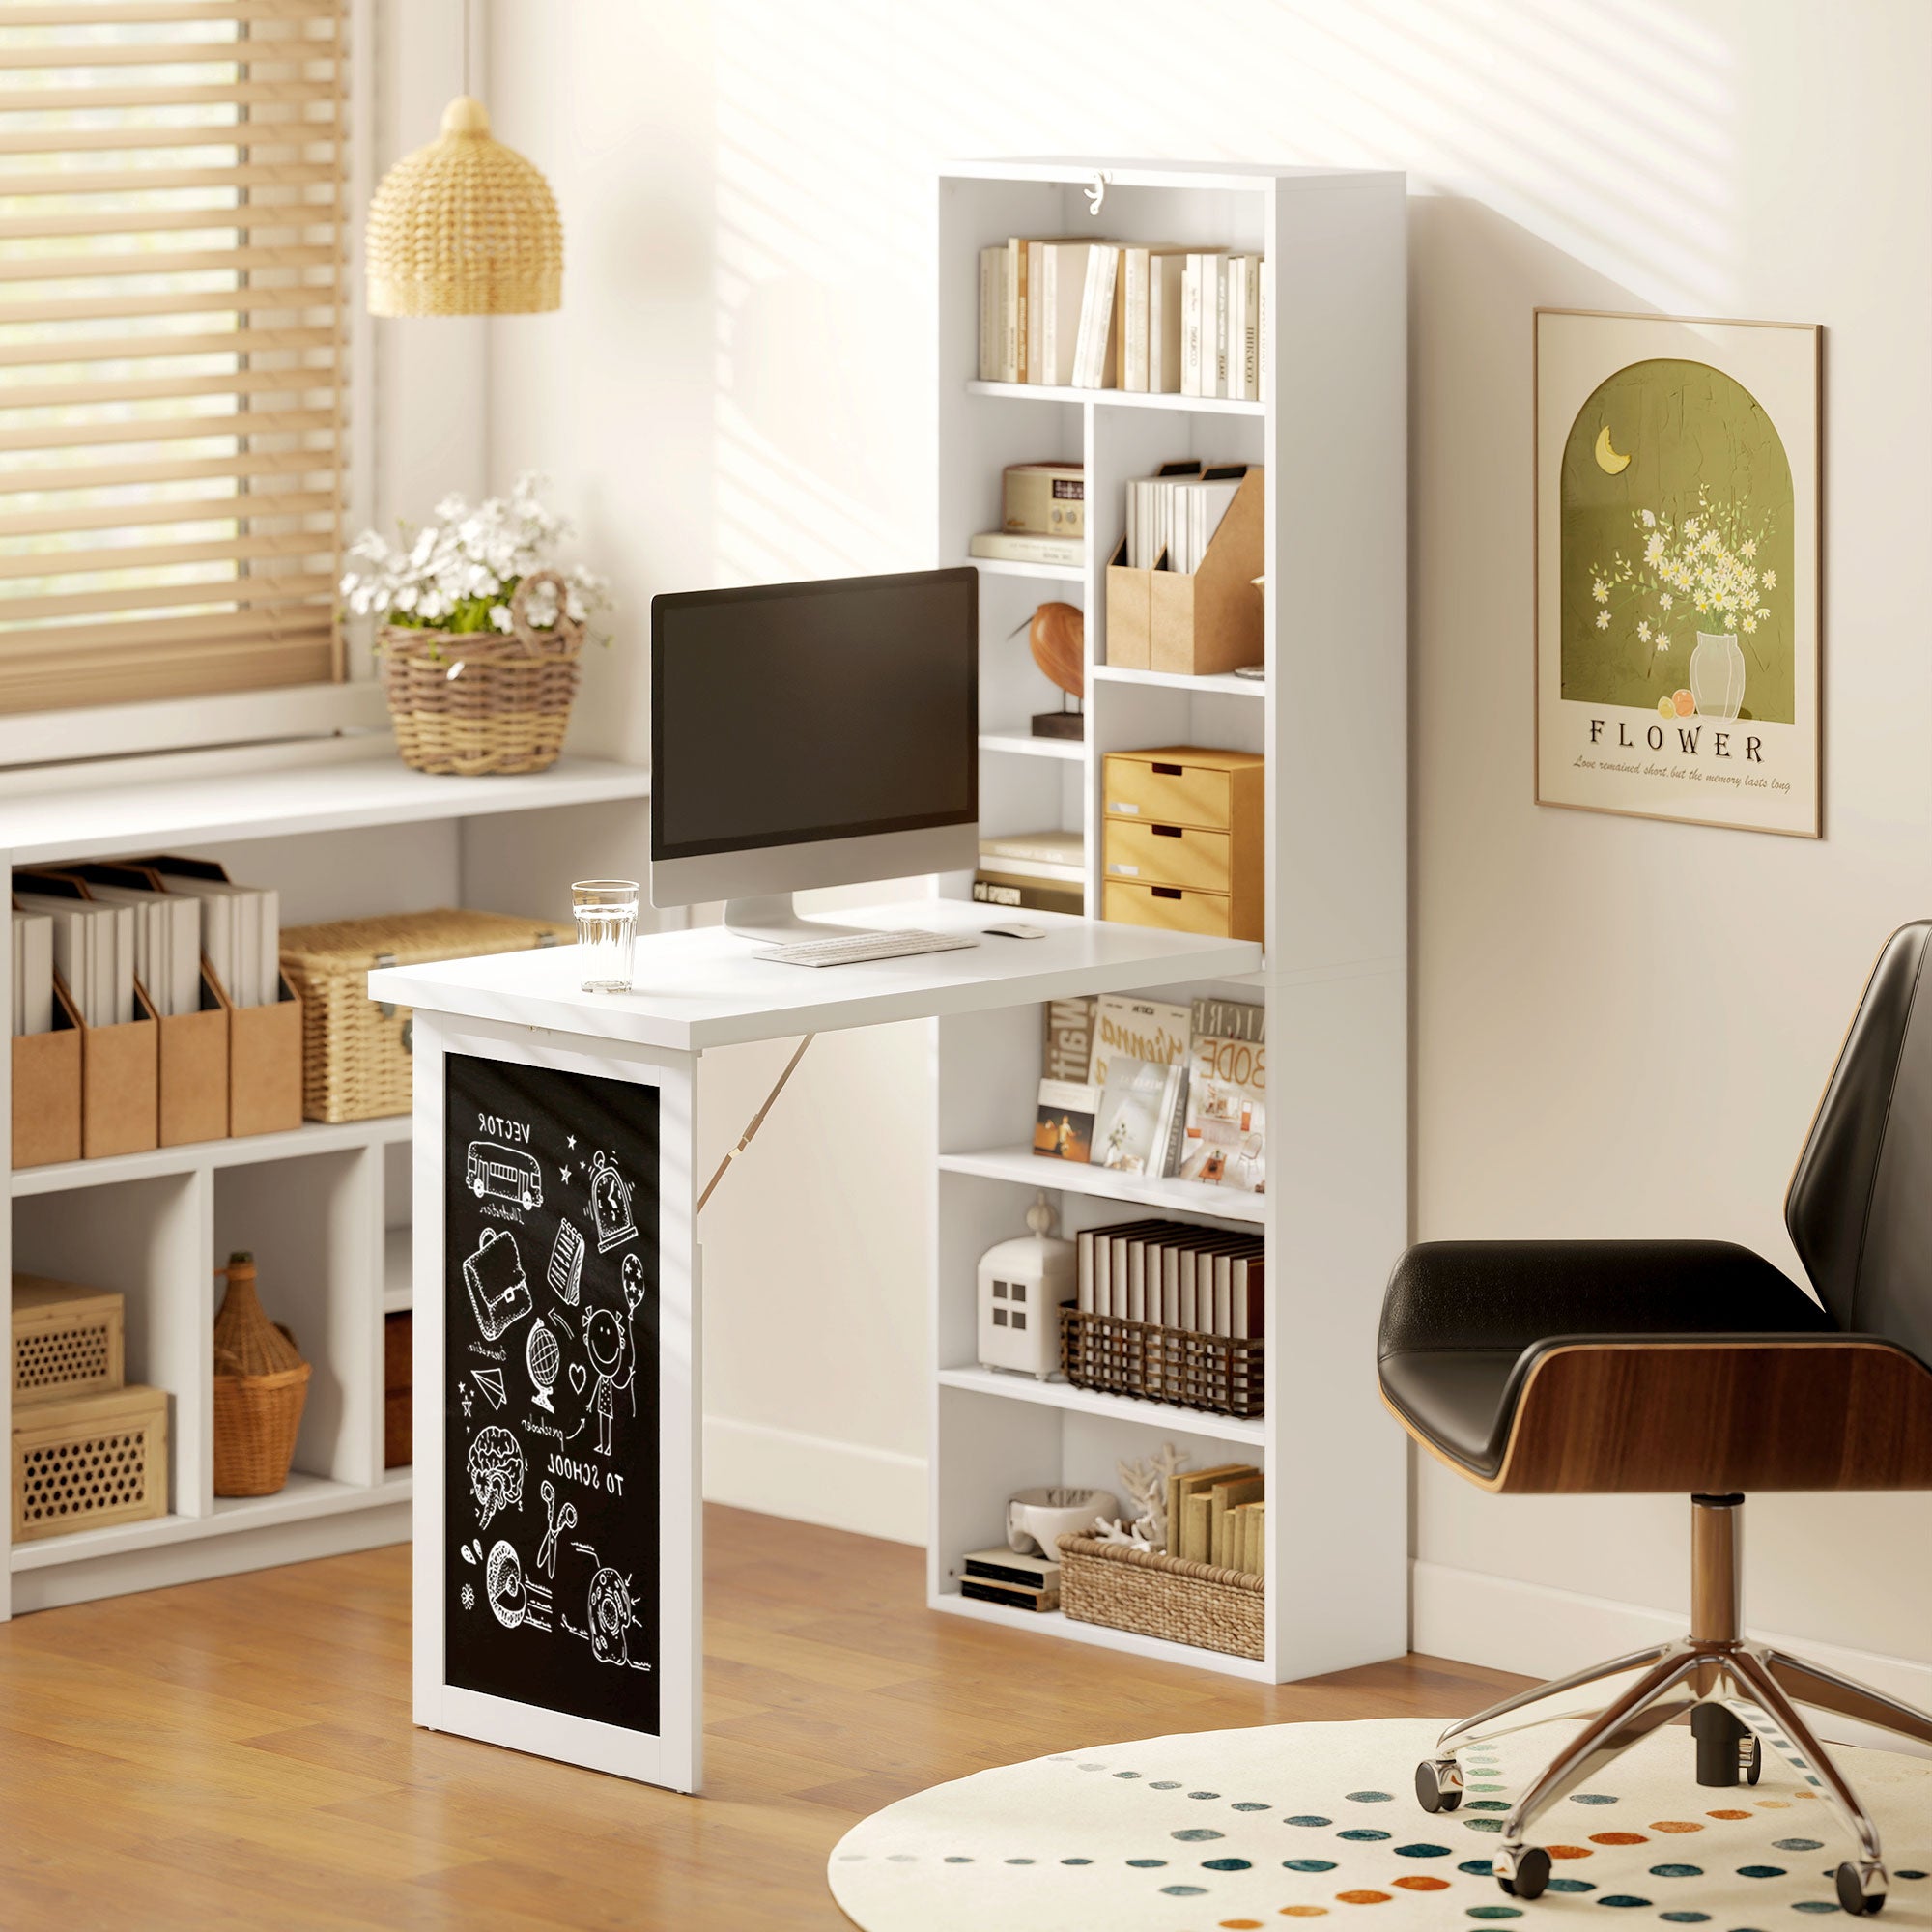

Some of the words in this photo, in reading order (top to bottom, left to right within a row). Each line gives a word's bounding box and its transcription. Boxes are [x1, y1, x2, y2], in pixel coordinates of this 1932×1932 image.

[1590, 720, 1763, 763] FLOWER
[1573, 754, 1596, 770] Love
[1599, 763, 1641, 775] remained
[1689, 767, 1703, 781] the
[1705, 774, 1741, 787] memory
[1745, 774, 1769, 789] lasts
[1771, 778, 1792, 795] long
